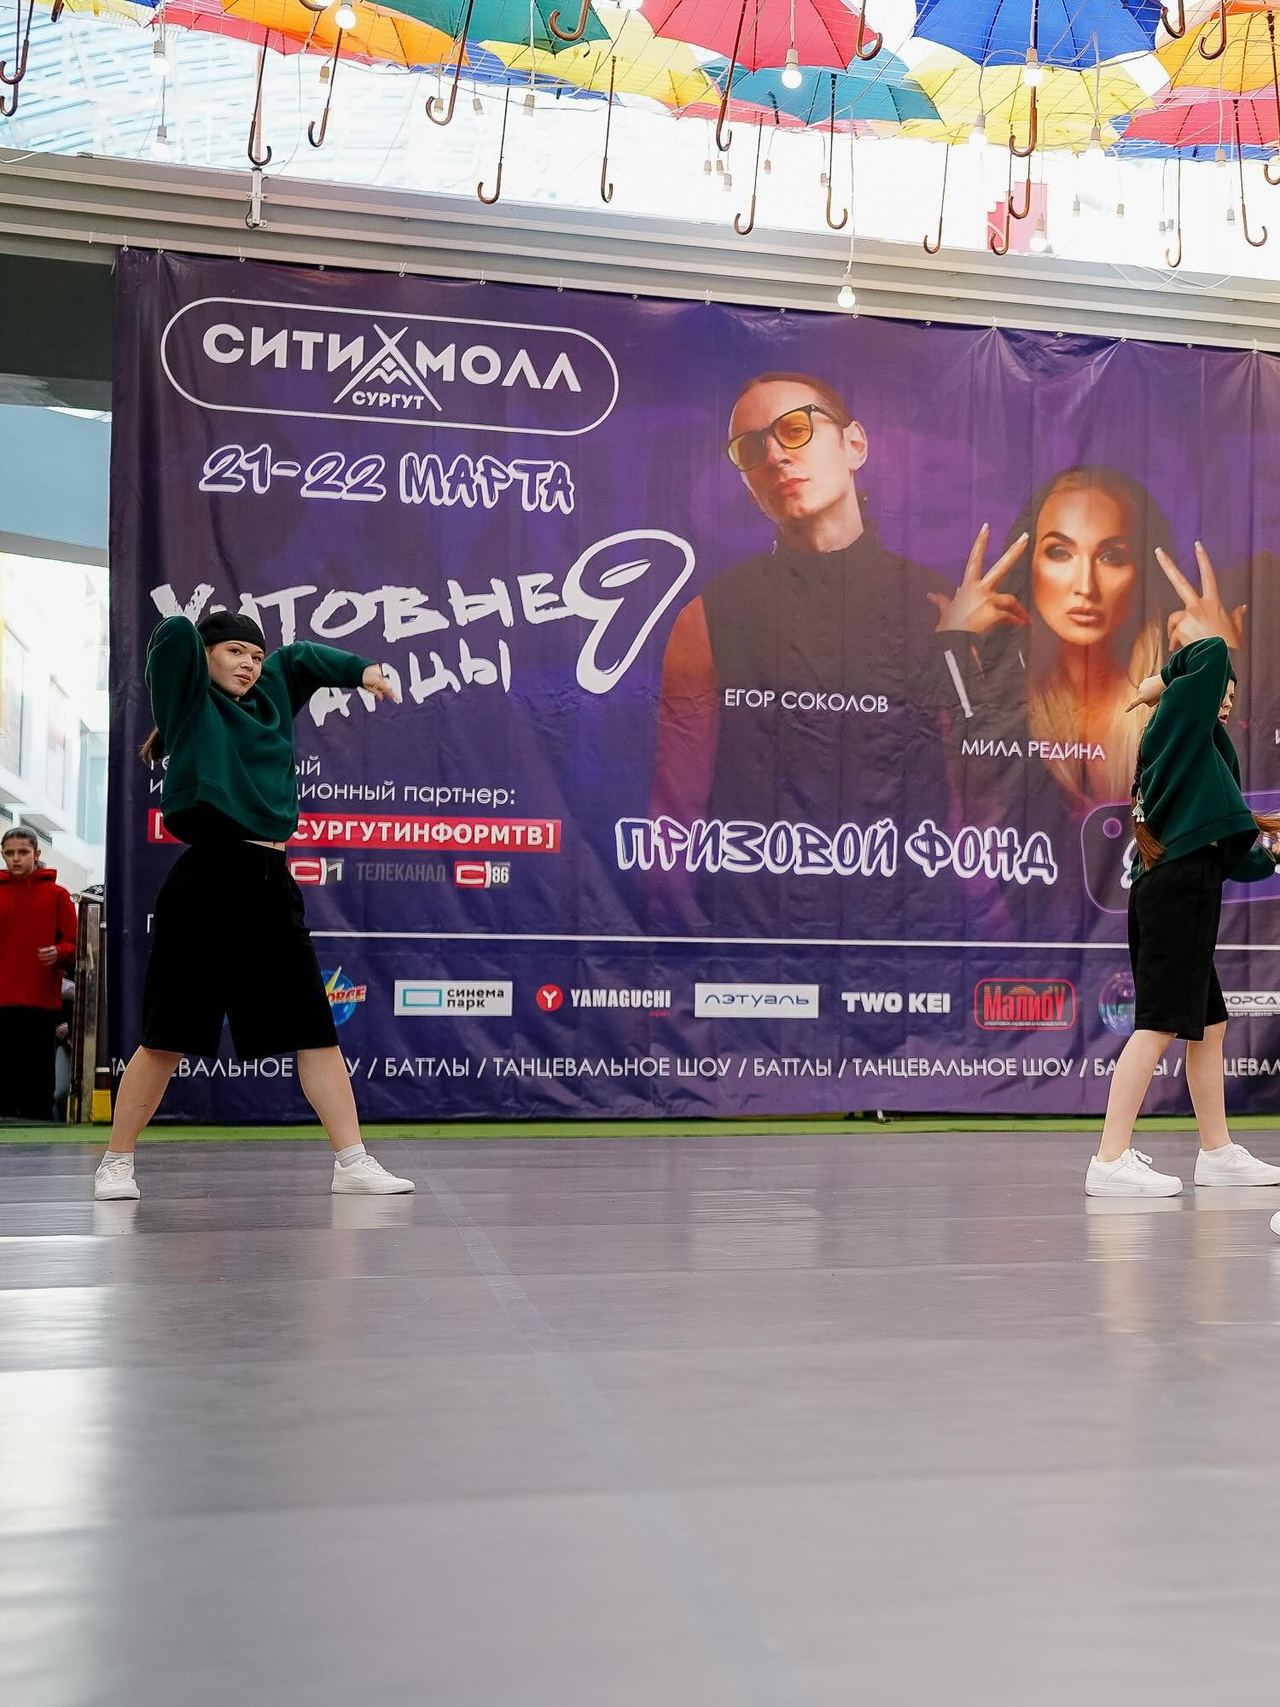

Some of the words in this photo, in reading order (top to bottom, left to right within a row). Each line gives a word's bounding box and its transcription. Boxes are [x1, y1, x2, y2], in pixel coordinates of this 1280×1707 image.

[202, 323, 364, 372] СИТИ
[416, 340, 582, 393] МОЛЛ
[352, 389, 424, 409] СУРГУТ
[199, 443, 388, 501] 21-22
[399, 451, 575, 515] МАРТА
[725, 688, 775, 708] ЕГОР
[781, 690, 889, 713] СОКОЛОВ
[961, 738, 1023, 758] МИЛА
[1028, 740, 1106, 761] РЕДИНА
[404, 785, 516, 809] партнер:
[615, 815, 898, 876] ПРИЗОВОЙ
[905, 818, 1058, 885] ФОНД
[356, 860, 446, 883] ТЕЛЕКАНАЛ
[447, 987, 505, 998] синема
[570, 988, 671, 1008] YAMAGUCHI
[841, 992, 903, 1013] TWO
[908, 992, 951, 1013] KEI
[447, 998, 486, 1011] парк
[385, 1057, 470, 1077] БАТТЛЫ
[493, 1057, 670, 1078] ТАНЦЕВАЛЬНОЕ
[676, 1057, 731, 1077] ШОУ
[754, 1057, 832, 1076] БАТТЛЫ
[854, 1057, 1017, 1078] ТАНЦЕВАЛЬНОЕ
[1022, 1057, 1074, 1077] ШОУ
